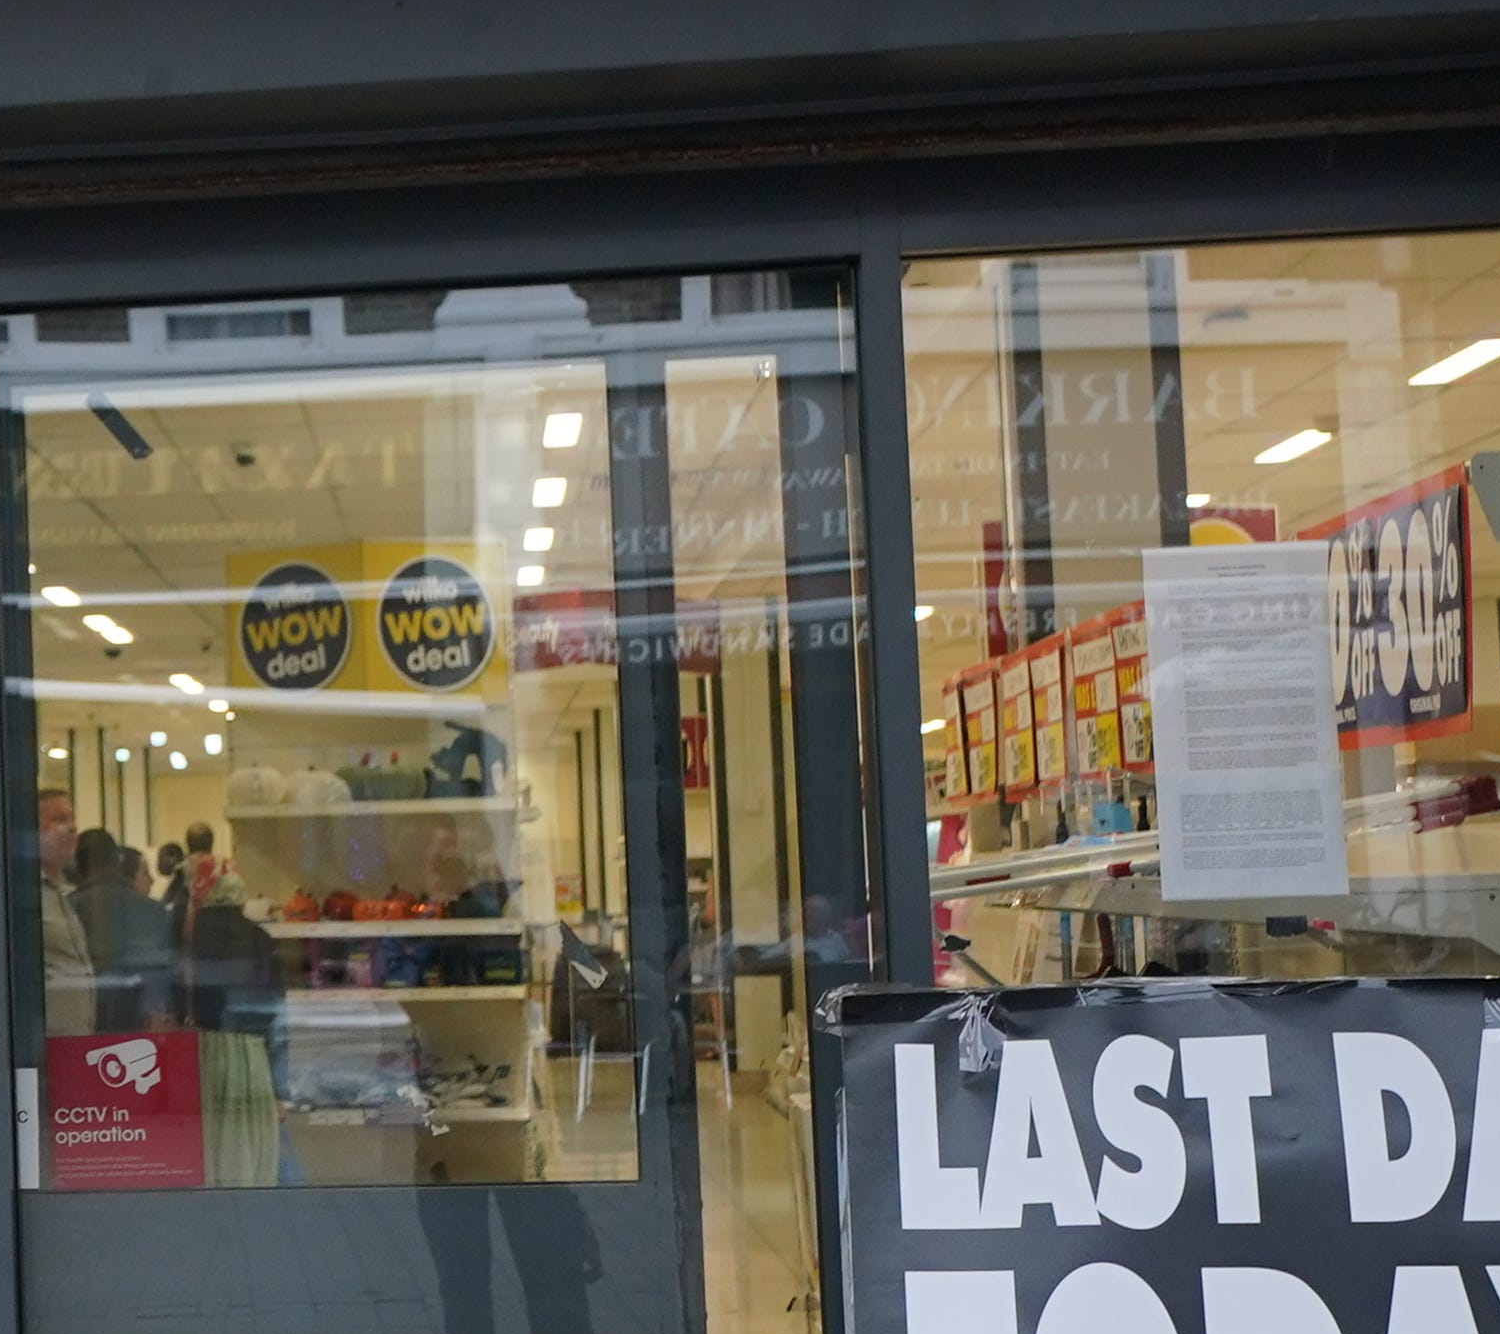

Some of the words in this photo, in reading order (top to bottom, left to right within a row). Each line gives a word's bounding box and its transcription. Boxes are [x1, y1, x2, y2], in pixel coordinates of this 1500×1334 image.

[402, 574, 459, 605] wilko
[246, 604, 343, 653] WOW
[384, 600, 486, 645] WOW
[266, 642, 328, 680] deal
[406, 638, 472, 674] deal
[1435, 607, 1462, 688] OFF
[54, 1107, 108, 1124] CCTV
[112, 1107, 130, 1123] in
[893, 1033, 1272, 1230] LAST
[55, 1126, 147, 1147] operation
